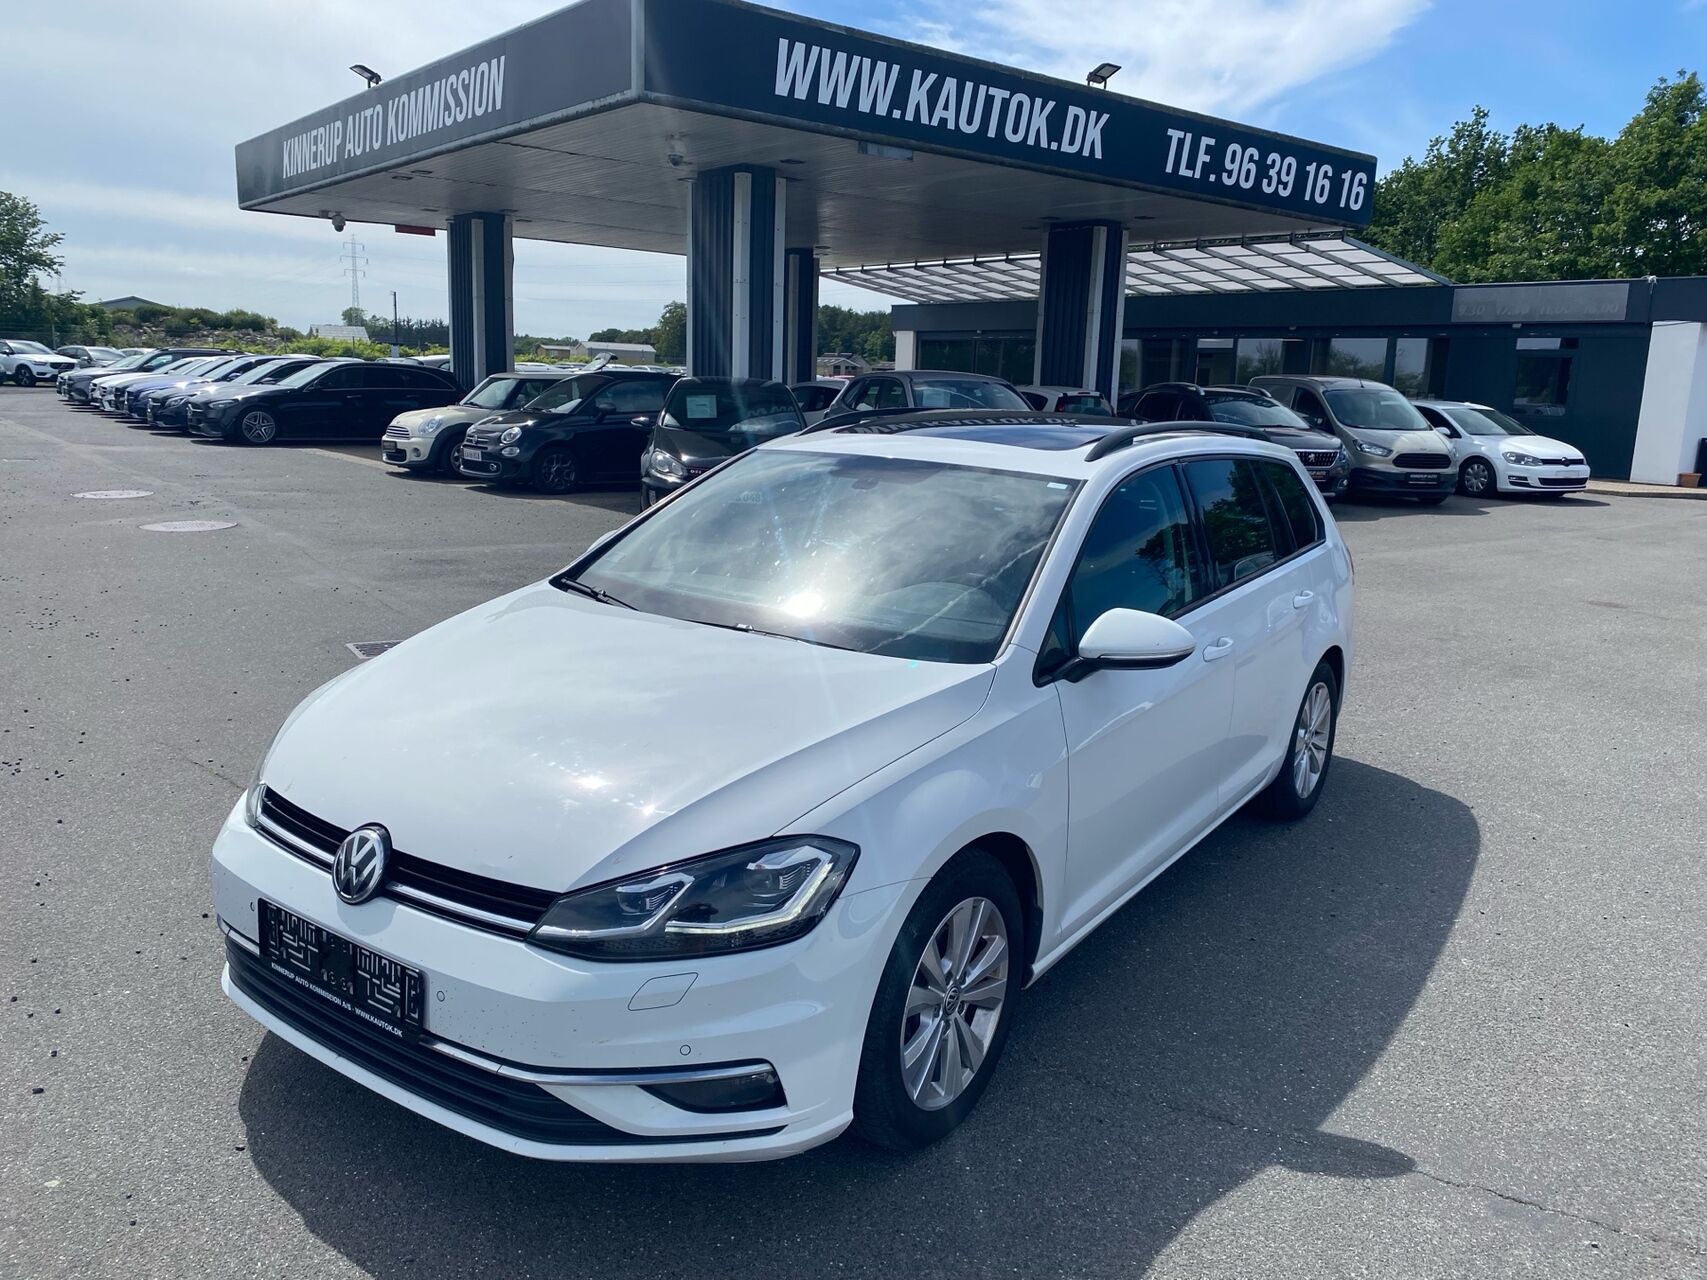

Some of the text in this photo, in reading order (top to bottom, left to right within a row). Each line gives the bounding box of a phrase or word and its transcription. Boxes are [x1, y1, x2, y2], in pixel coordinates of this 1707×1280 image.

[282, 55, 506, 178] KINNERUP AUTO KOMMISSION
[774, 38, 1368, 211] WWW.KAUTOK.DK TLF. 96 39 16 16
[271, 962, 295, 979] KINNERUP
[295, 975, 309, 988] AUTO
[309, 983, 342, 1006] KOMMISSION
[354, 1007, 403, 1038] WWW.KAUTOK.DK
